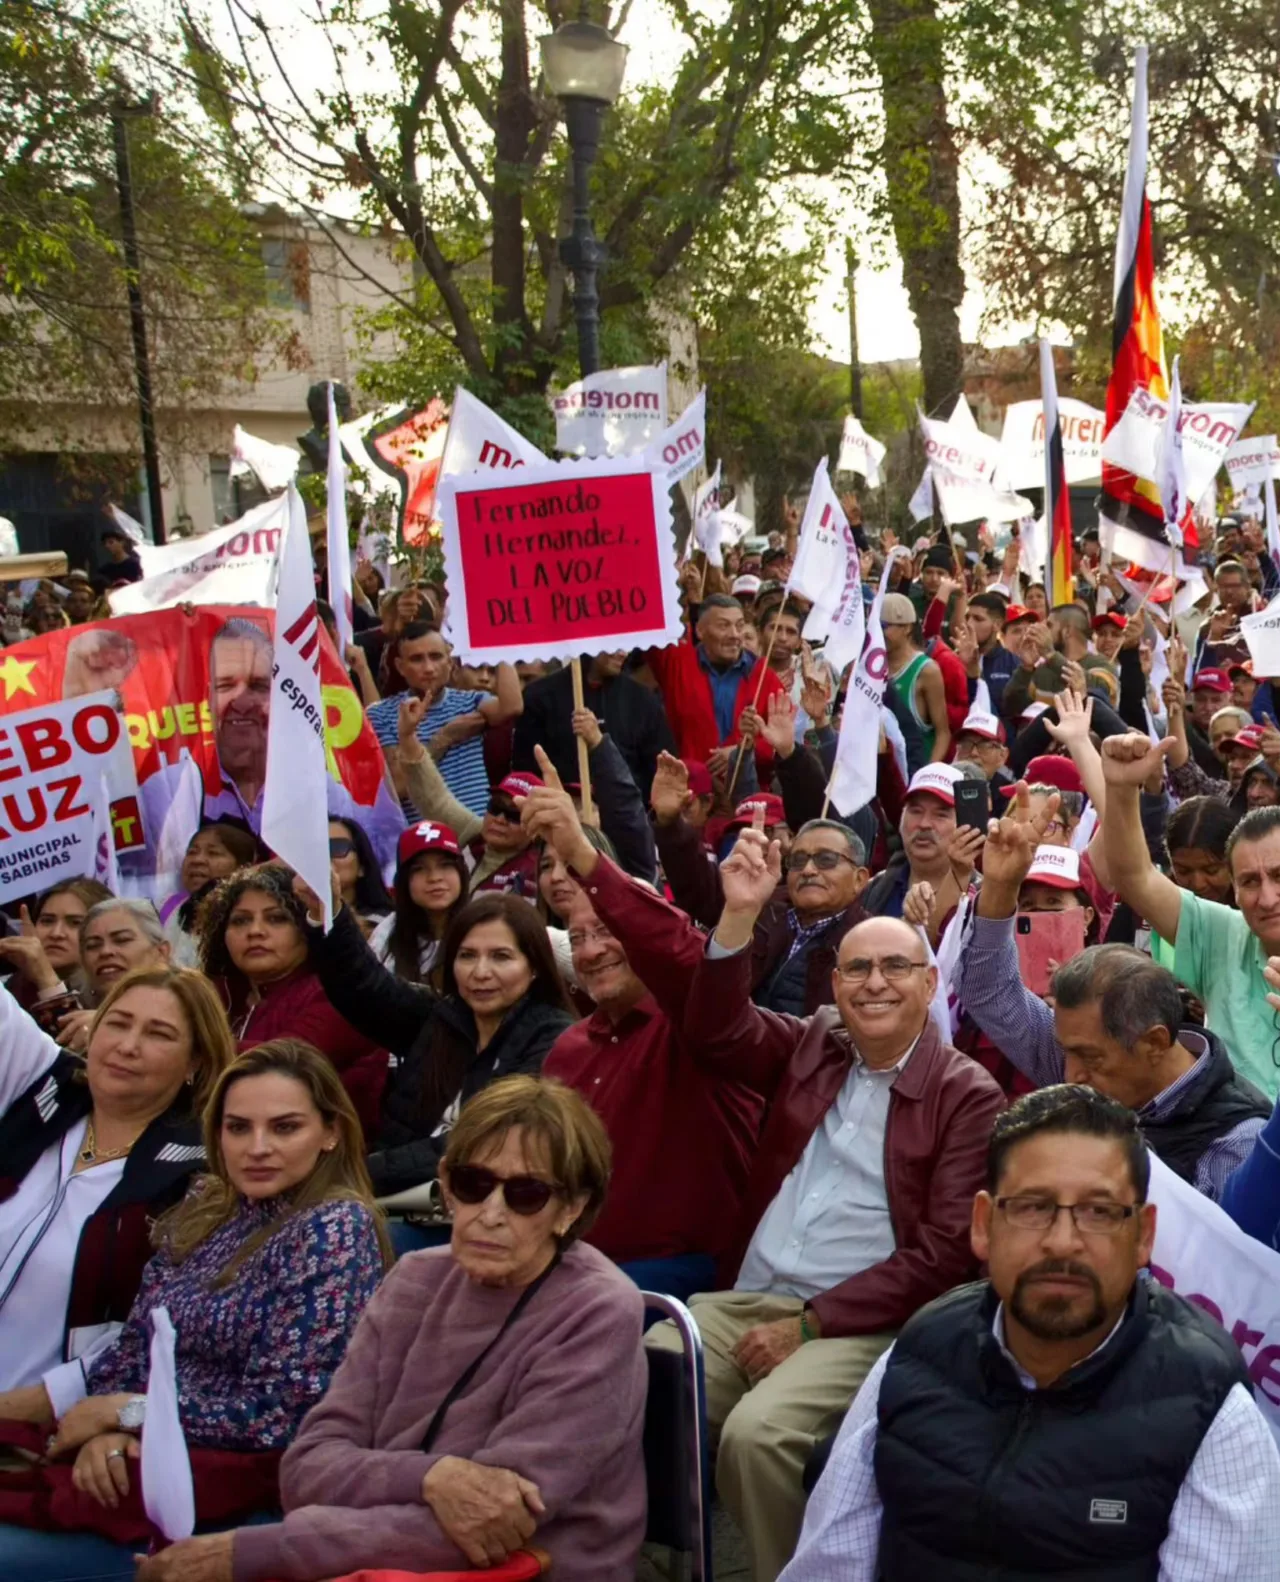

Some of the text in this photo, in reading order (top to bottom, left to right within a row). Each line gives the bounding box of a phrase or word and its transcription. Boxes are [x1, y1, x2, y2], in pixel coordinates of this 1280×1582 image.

[473, 484, 602, 524] Fernando
[486, 586, 647, 627] DEL PUEBLO
[0, 775, 90, 841] UZ
[1, 851, 71, 884] SABINAS
